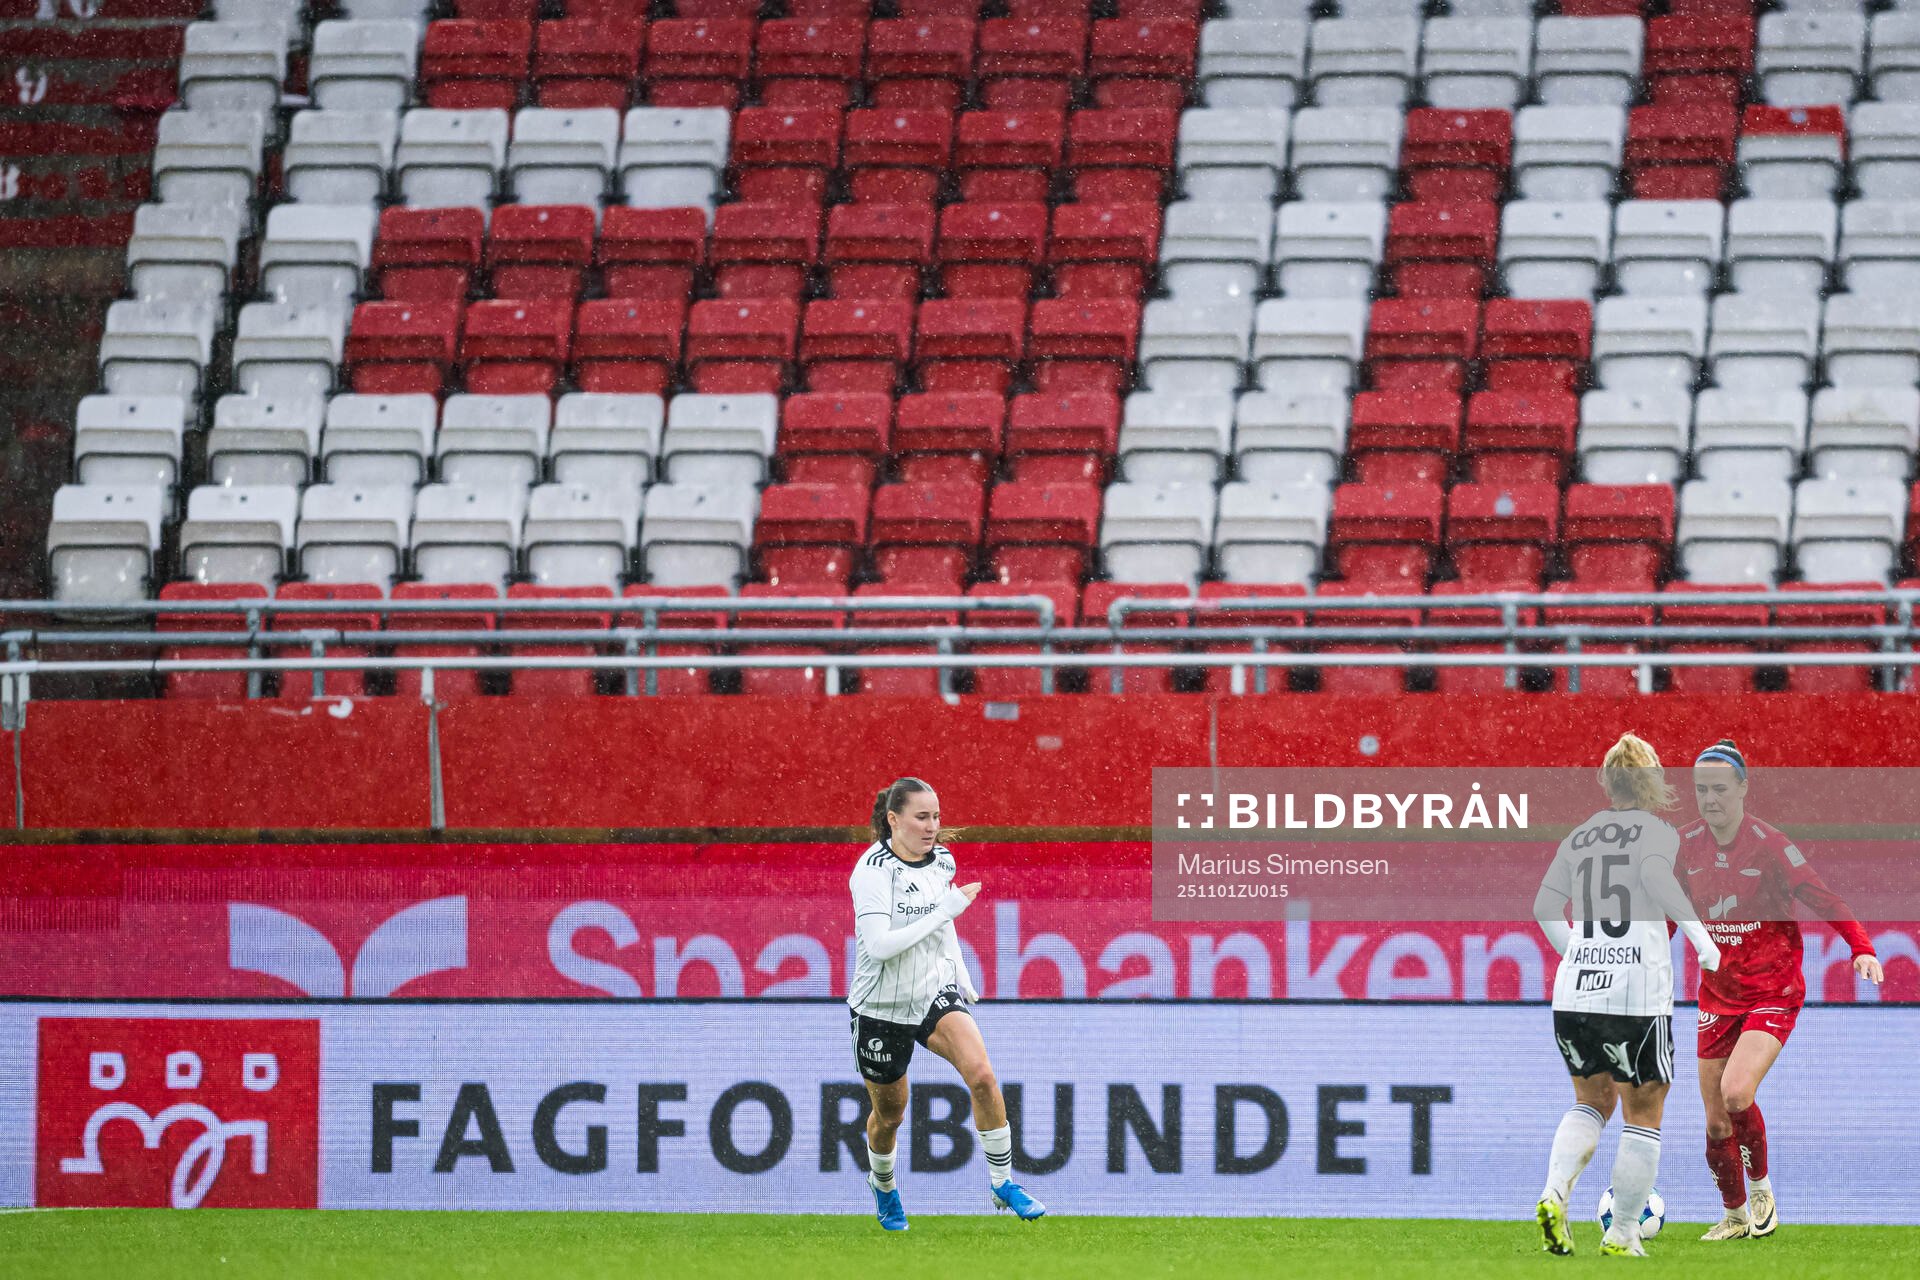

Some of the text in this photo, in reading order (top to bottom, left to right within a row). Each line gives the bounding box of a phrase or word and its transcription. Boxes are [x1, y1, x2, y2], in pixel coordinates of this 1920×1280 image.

[1571, 823, 1643, 850] coop
[1577, 854, 1631, 938] 15
[1711, 932, 1743, 947] Norge
[1580, 971, 1613, 991] MOT
[934, 996, 951, 1010] 16
[371, 1081, 1453, 1177] FAGFORBUNDET
